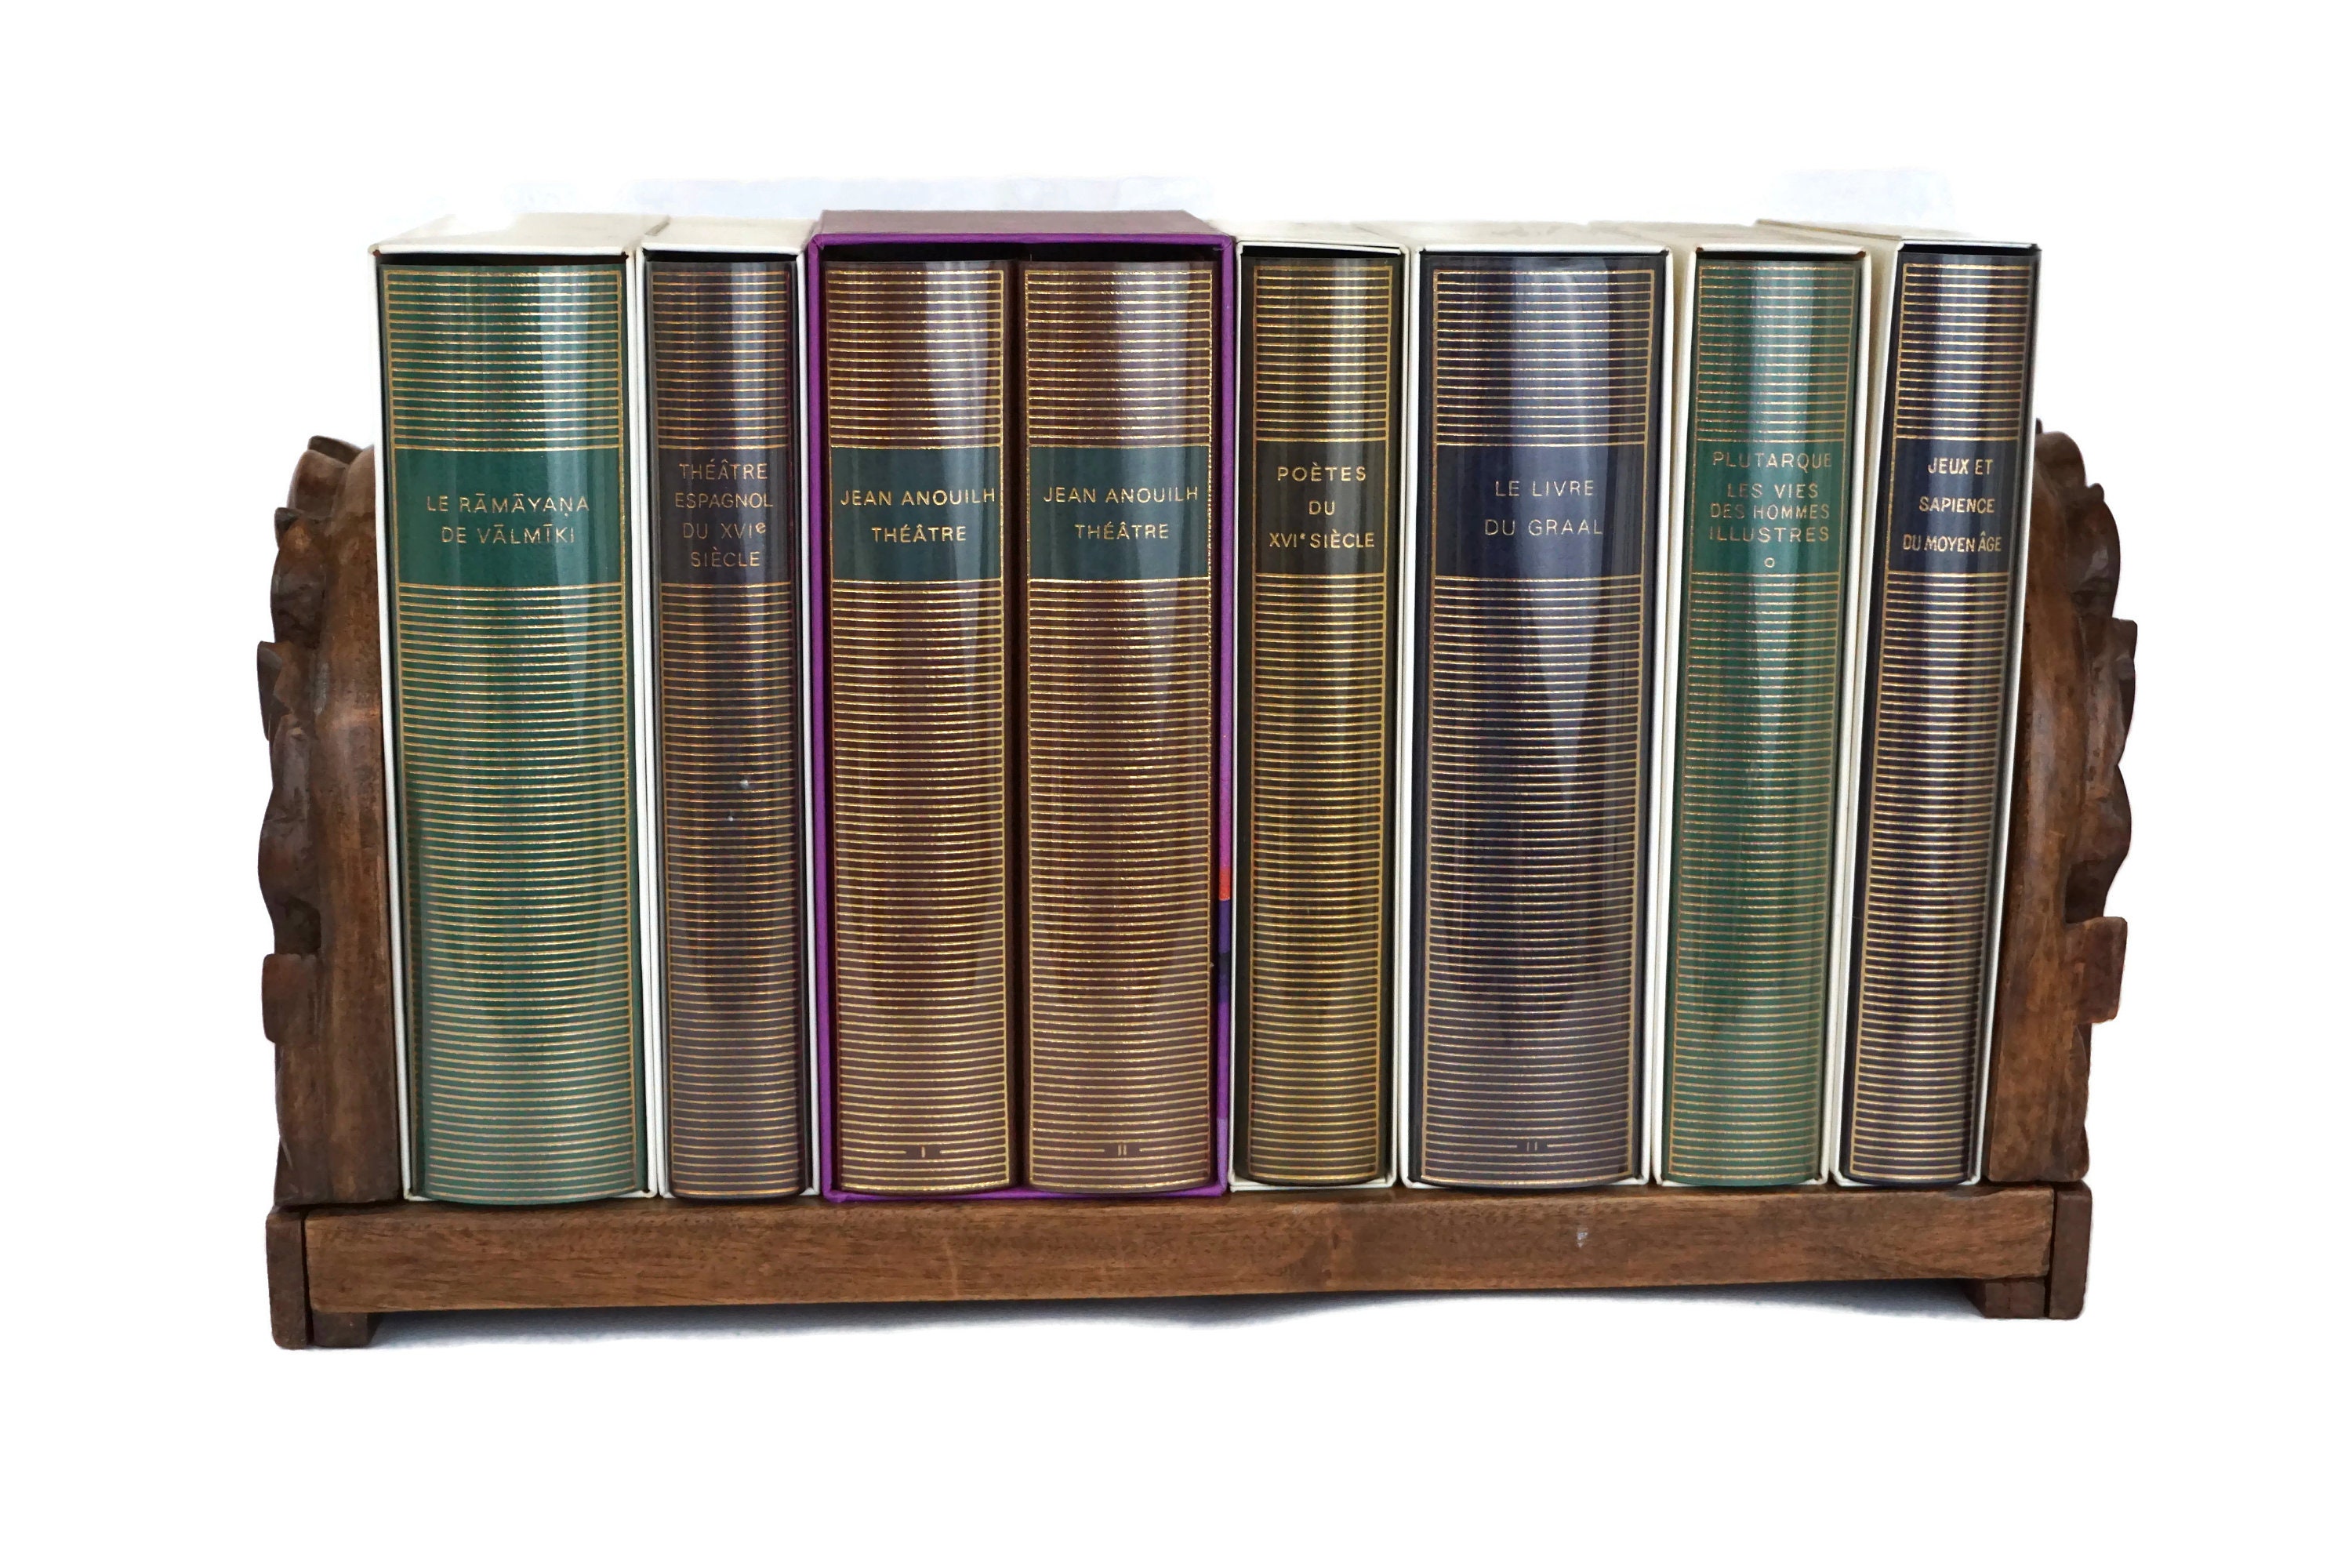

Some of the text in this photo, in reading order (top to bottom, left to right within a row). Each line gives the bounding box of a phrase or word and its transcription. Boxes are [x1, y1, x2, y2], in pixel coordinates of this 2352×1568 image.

[680, 459, 768, 480] THÉÂTRE
[1277, 462, 1367, 482] POÈTES
[1712, 452, 1832, 474] PLUTARQUE
[1927, 457, 1994, 475] JEUX ET
[840, 488, 995, 506] JEAN ANOUILH
[1044, 486, 1198, 503] JEAN ANOUILH
[1496, 480, 1594, 496] LE LIVRE
[1727, 483, 1818, 499] LES VIES
[426, 495, 448, 511] LE
[676, 492, 773, 508] ESPAGNOL
[1308, 500, 1335, 515] DU
[1918, 496, 1994, 514] SAPIENCE
[1711, 502, 1830, 520] DES HOMMES
[441, 526, 466, 543] DE
[684, 523, 708, 539] DU
[871, 523, 966, 543] THÉÂTRE
[1075, 521, 1168, 540] THÉÂTRE
[1485, 518, 1602, 535] DU GRAAL
[1709, 526, 1829, 543] ILLUSTRES
[1310, 528, 1374, 548] SIÈCLE
[1903, 531, 2002, 552] DU MOYEN ÂGE
[691, 547, 760, 568] SIÈCLE
